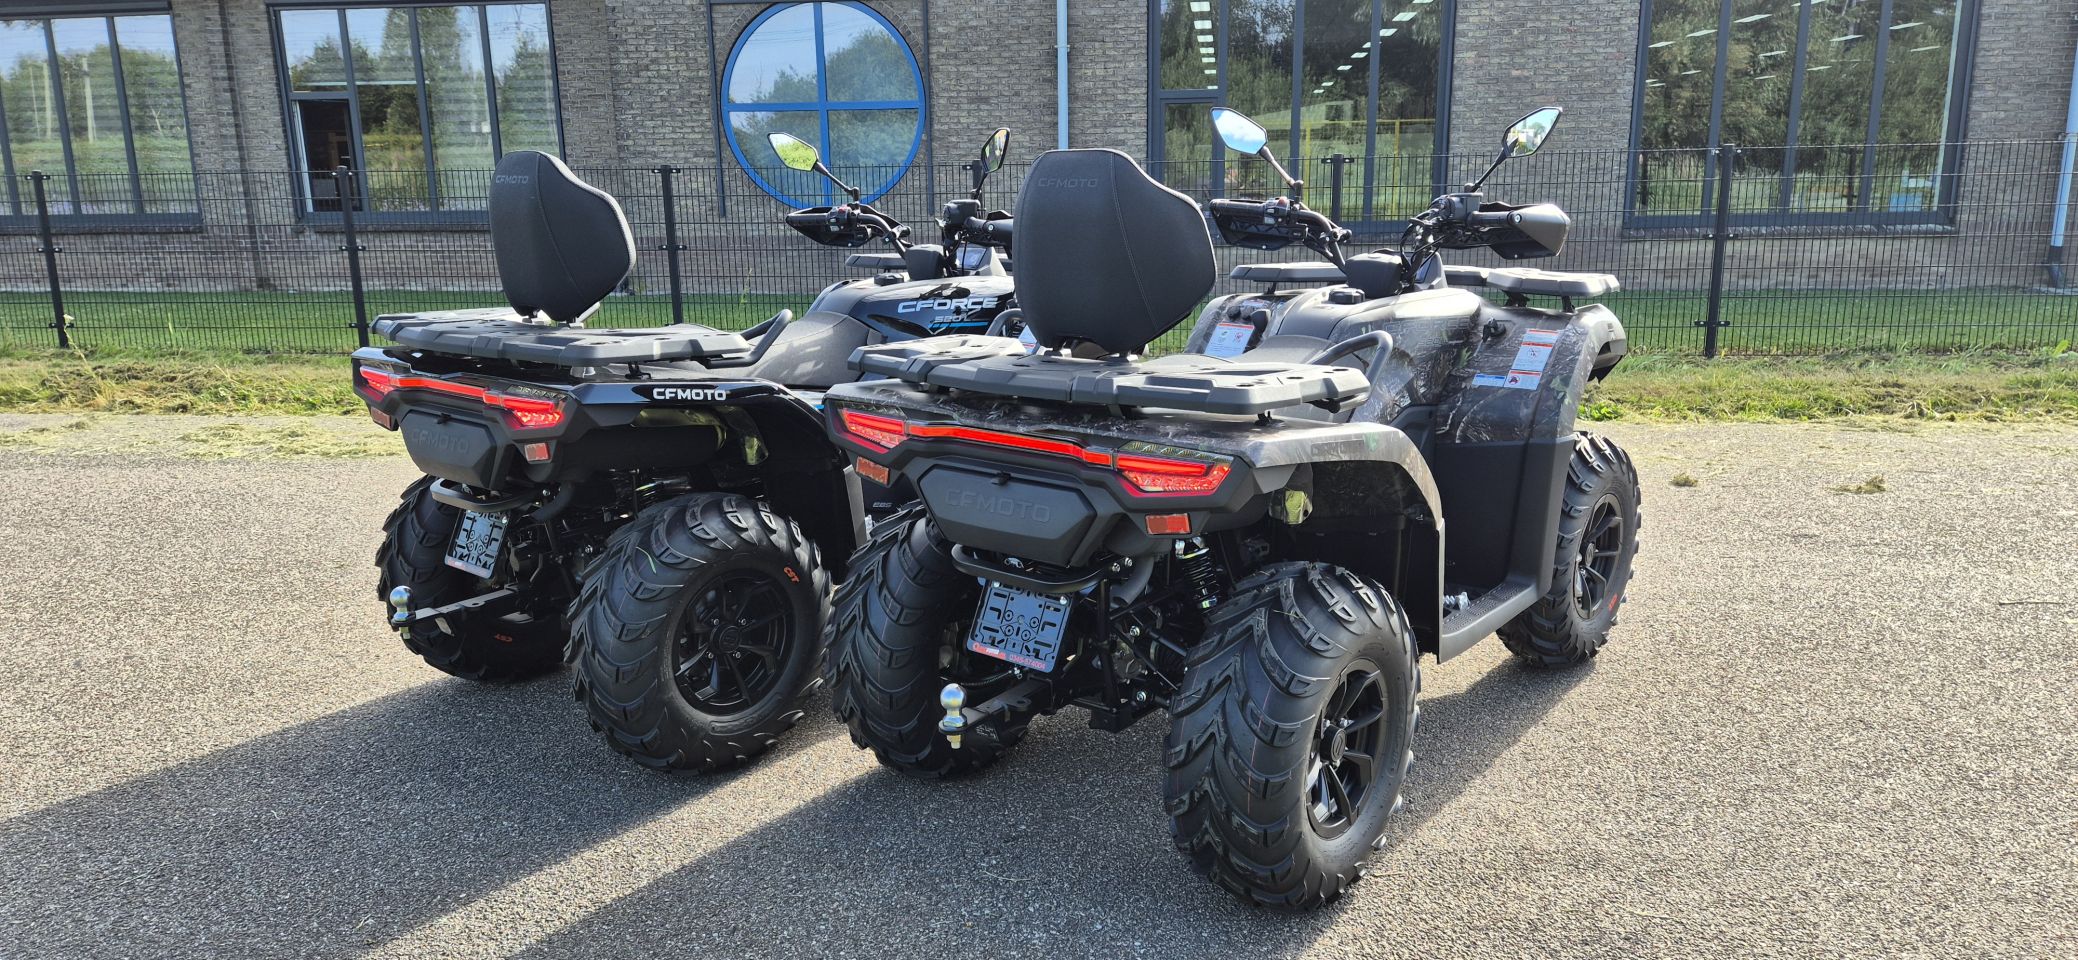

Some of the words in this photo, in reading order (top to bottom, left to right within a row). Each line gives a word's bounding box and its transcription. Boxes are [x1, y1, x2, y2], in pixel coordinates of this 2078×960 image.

[495, 175, 529, 184] CFMOTO
[1038, 177, 1098, 188] CFMOTO
[897, 297, 998, 313] CFORCE
[652, 387, 727, 401] CFMOTO
[946, 489, 1051, 523] CFMOTO
[783, 566, 800, 583] CST
